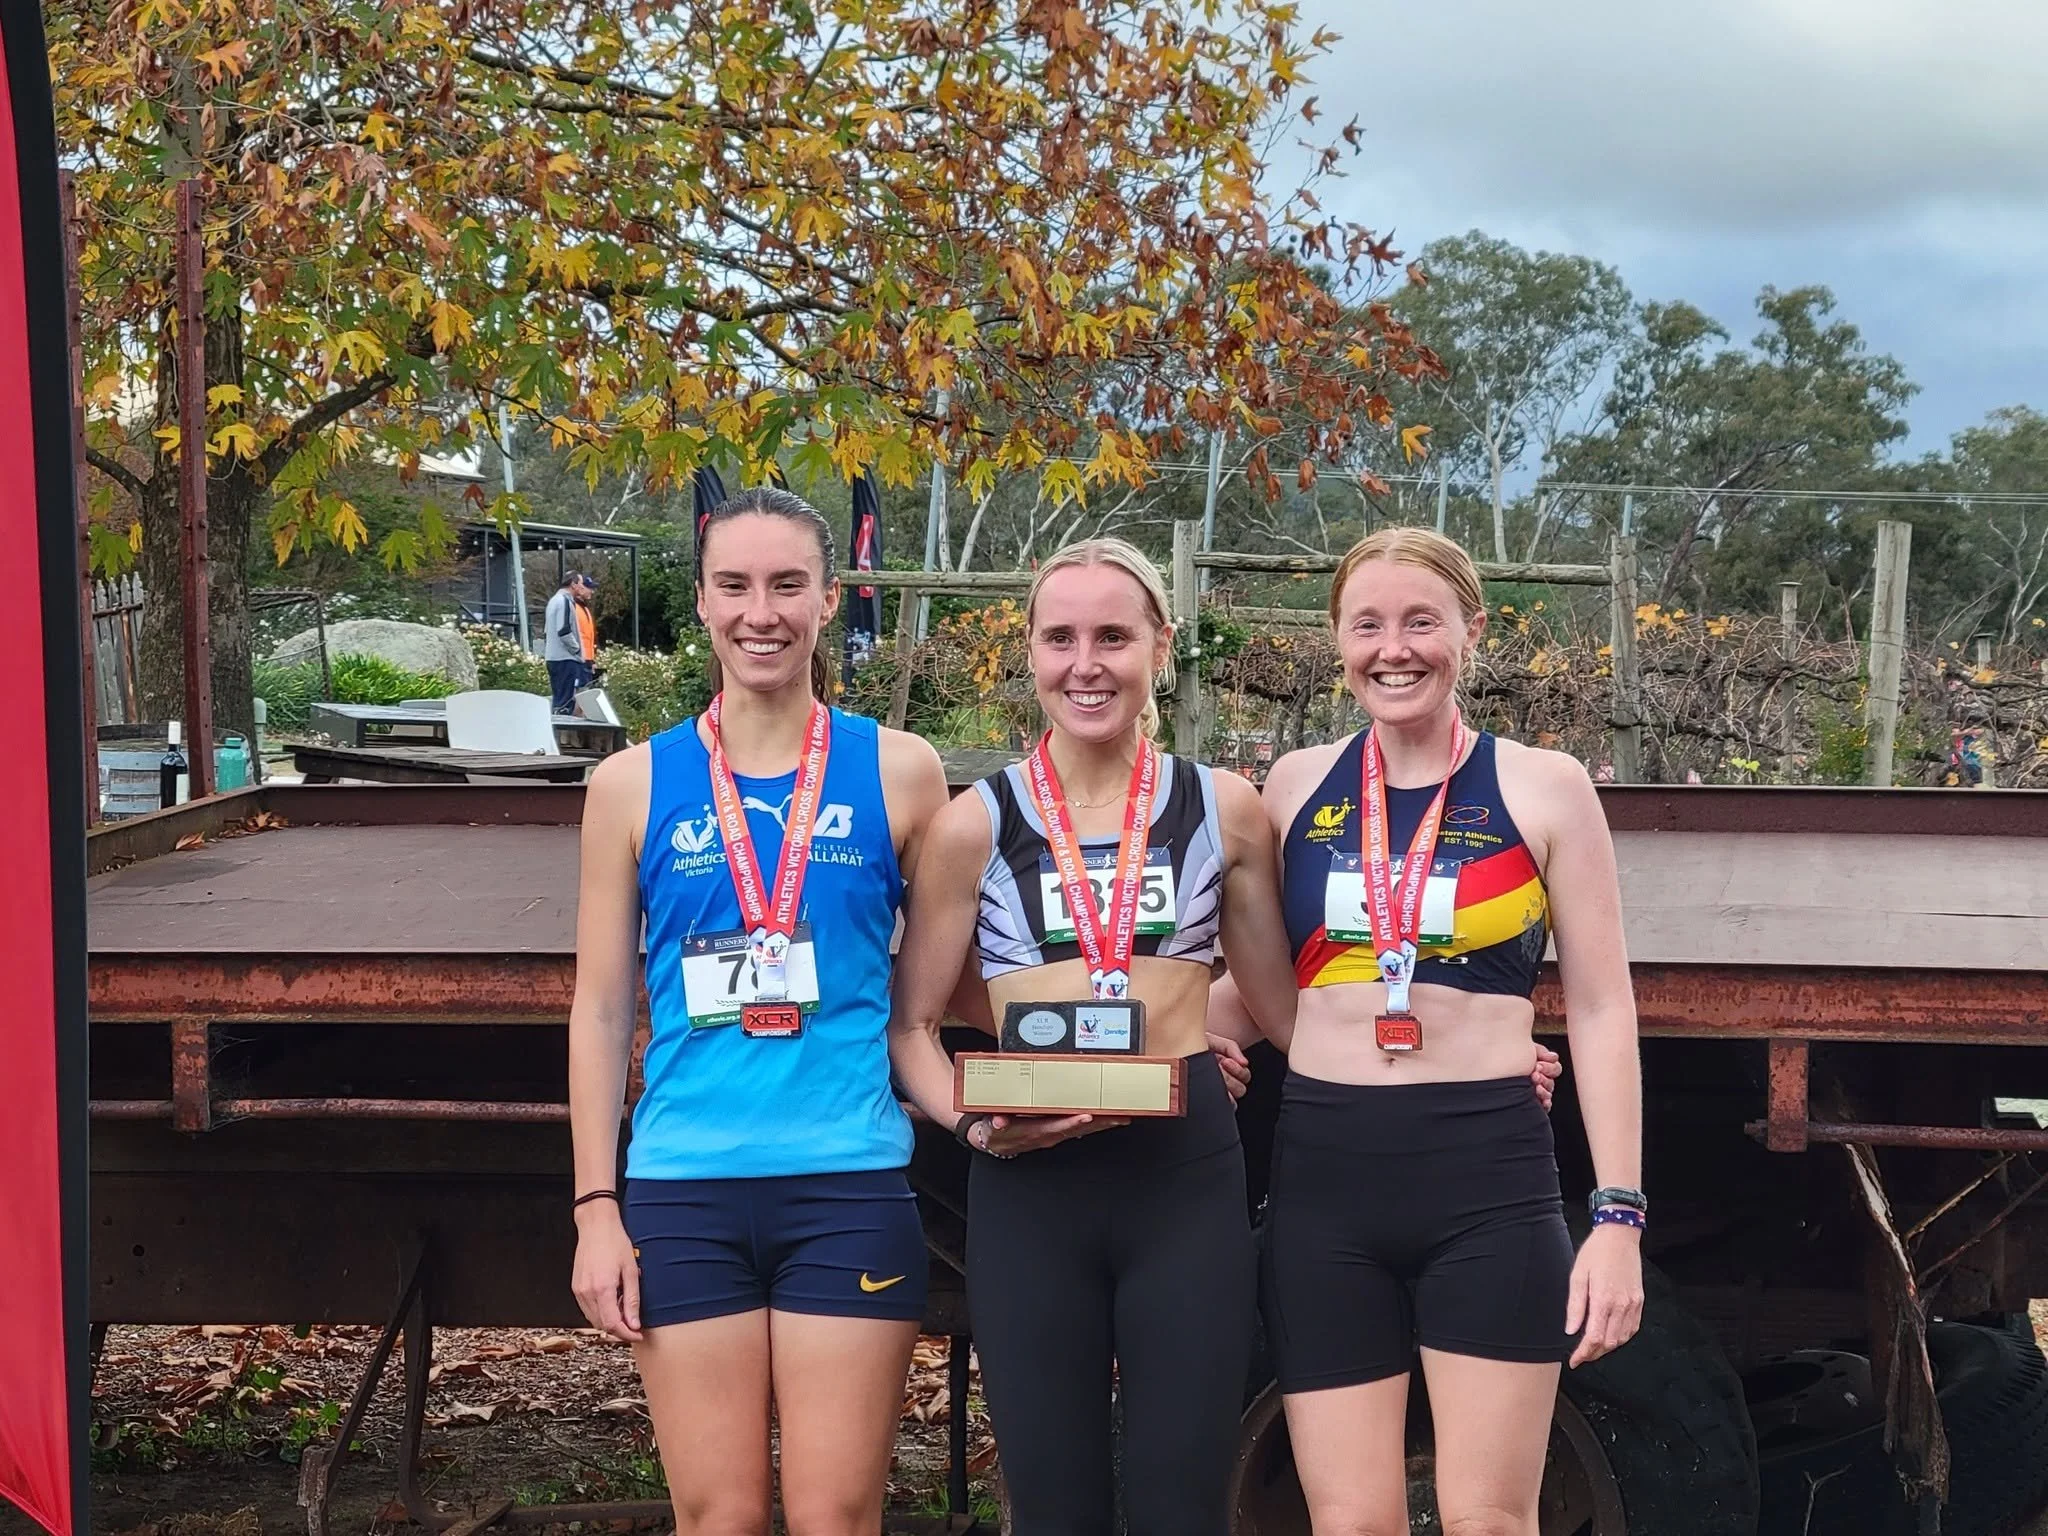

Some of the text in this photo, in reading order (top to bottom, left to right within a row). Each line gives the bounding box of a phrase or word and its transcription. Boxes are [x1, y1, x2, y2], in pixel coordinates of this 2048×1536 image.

[812, 713, 826, 738] ROAD
[713, 759, 733, 803] COUNTRY
[803, 747, 822, 790] COUNTRY
[1031, 749, 1047, 781] CTORIA
[1141, 759, 1153, 782] ROAD
[796, 790, 815, 823] CROSS
[1037, 780, 1055, 809] CROSS
[1132, 789, 1150, 831] COUNTRY
[1368, 778, 1380, 815] COUNTRY
[725, 812, 742, 841] ROAD
[1045, 809, 1068, 848] COUNTRY
[1304, 827, 1346, 839] Athletics
[1370, 814, 1382, 843] CROSS
[1417, 826, 1433, 853] ROAD
[1465, 831, 1503, 844] Athletics
[671, 851, 727, 873] Athletics
[786, 824, 808, 870] VICTORIA
[807, 850, 864, 867] ALLARAT
[808, 842, 860, 855] THLETICS
[1127, 831, 1144, 861] CROSS
[685, 866, 714, 878] Victoria
[1061, 857, 1079, 884] ROAD
[1370, 843, 1385, 887] VICTORIA
[732, 841, 763, 922] CHAMPIONSHIPS
[776, 870, 798, 924] ATHLETICS
[1121, 862, 1140, 907] VICTORIA
[1400, 853, 1427, 934] CHAMPIONSHIPS
[1069, 884, 1102, 965] CHAMPIONSHIPS
[1373, 887, 1394, 941] ATHLETICS
[1114, 907, 1134, 961] ATHLETICS
